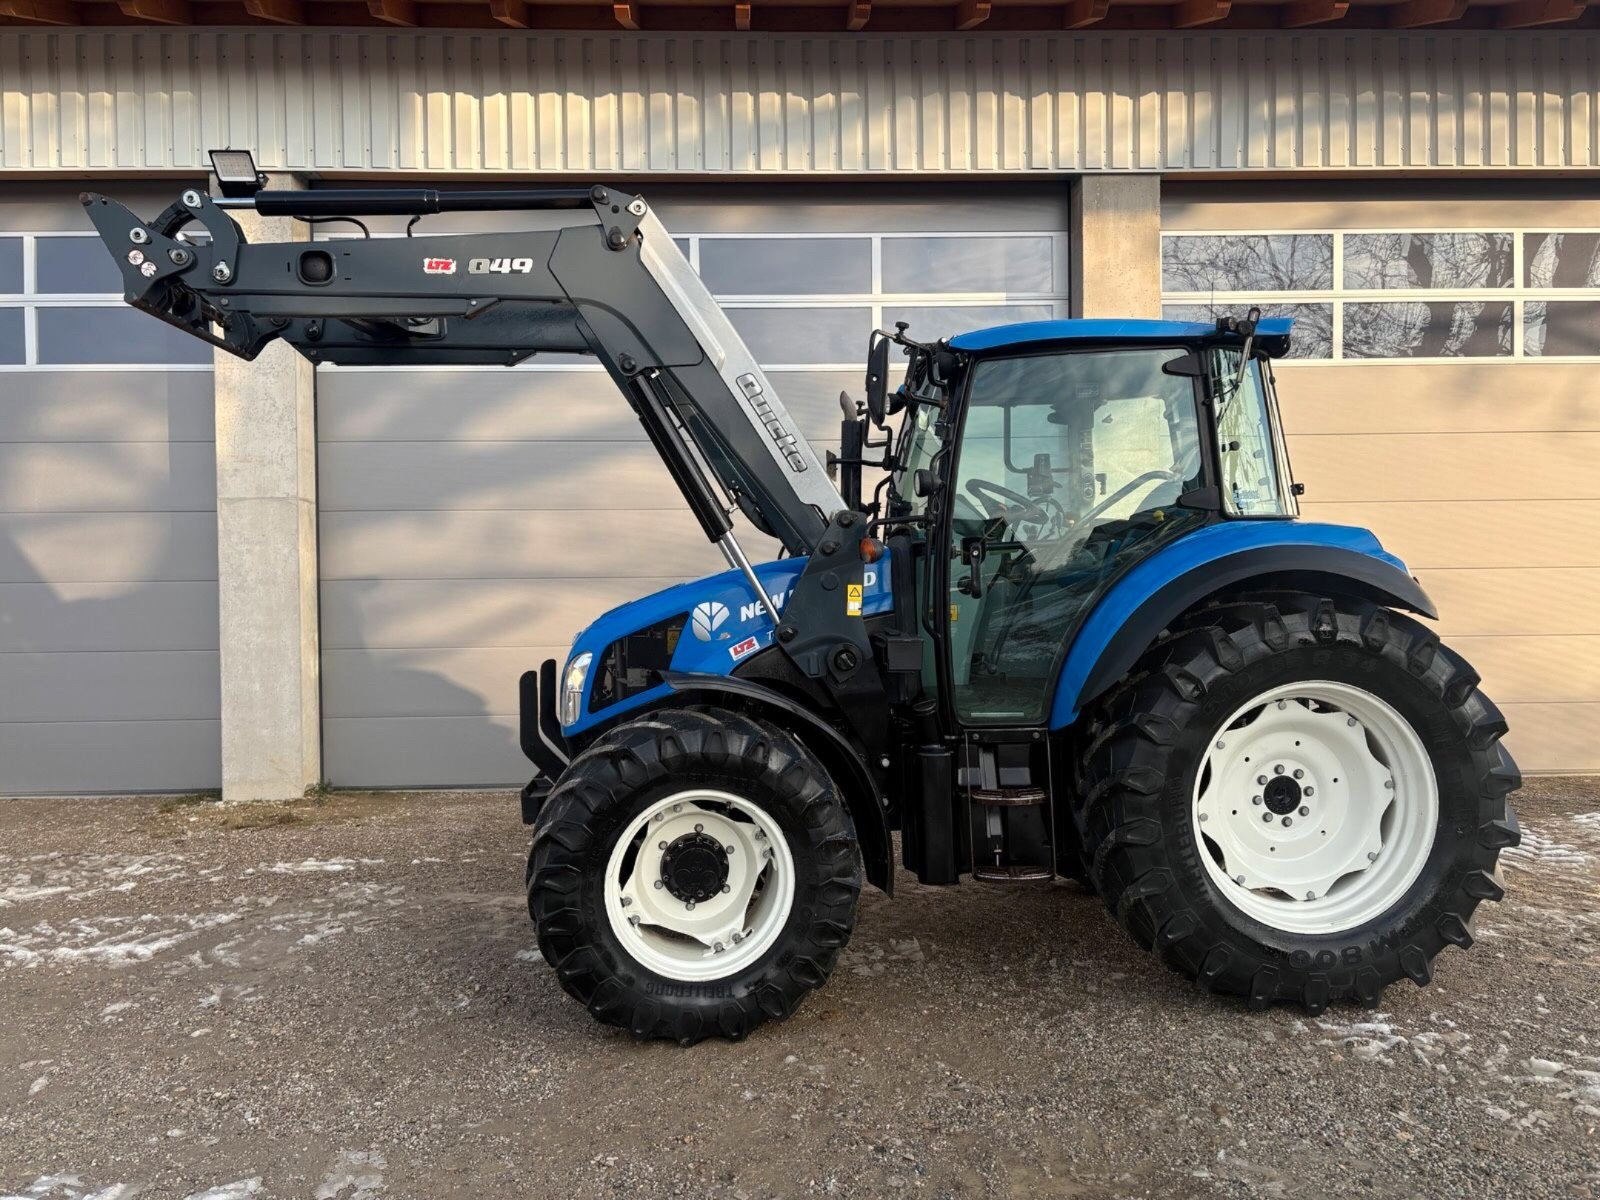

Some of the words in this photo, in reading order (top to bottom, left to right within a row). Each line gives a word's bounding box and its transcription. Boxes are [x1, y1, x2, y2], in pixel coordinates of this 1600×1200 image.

[425, 259, 454, 272] LTZ
[736, 372, 808, 473] Quicke
[740, 591, 785, 622] NEW
[731, 637, 757, 657] LTZ
